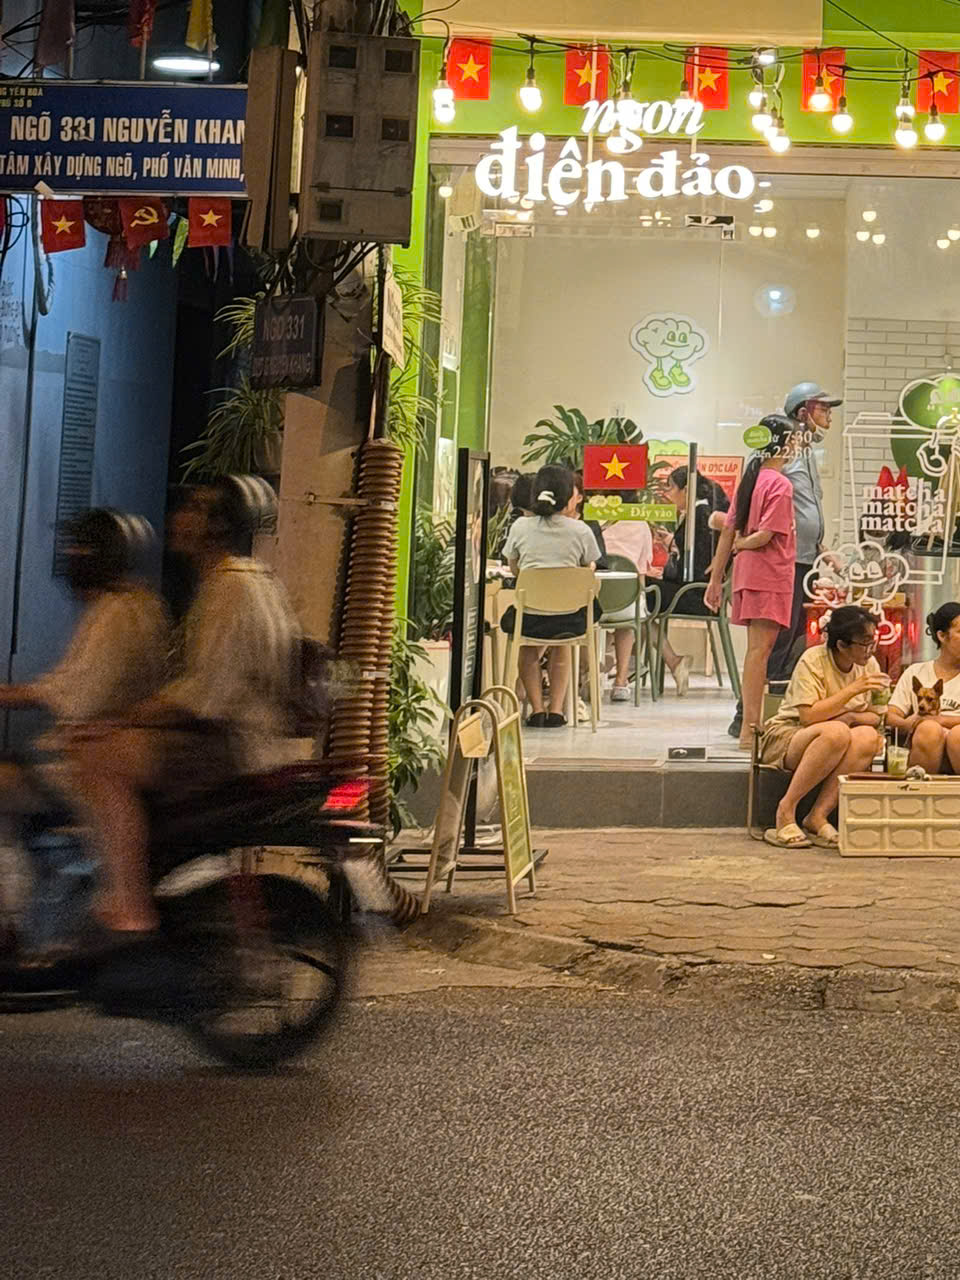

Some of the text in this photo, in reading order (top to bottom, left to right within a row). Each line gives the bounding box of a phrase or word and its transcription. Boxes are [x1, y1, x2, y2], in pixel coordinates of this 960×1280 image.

[10, 111, 52, 141] NGÕ
[60, 116, 96, 142] 331
[103, 109, 188, 143] NGUYỄN
[580, 98, 705, 154] ngon
[0, 151, 245, 182] TÂM XÂY DỰNG NGÕ, PHỐ VĂN MINH,
[635, 149, 756, 201] đảo
[861, 496, 945, 517] matcha
[862, 479, 946, 502] matcha
